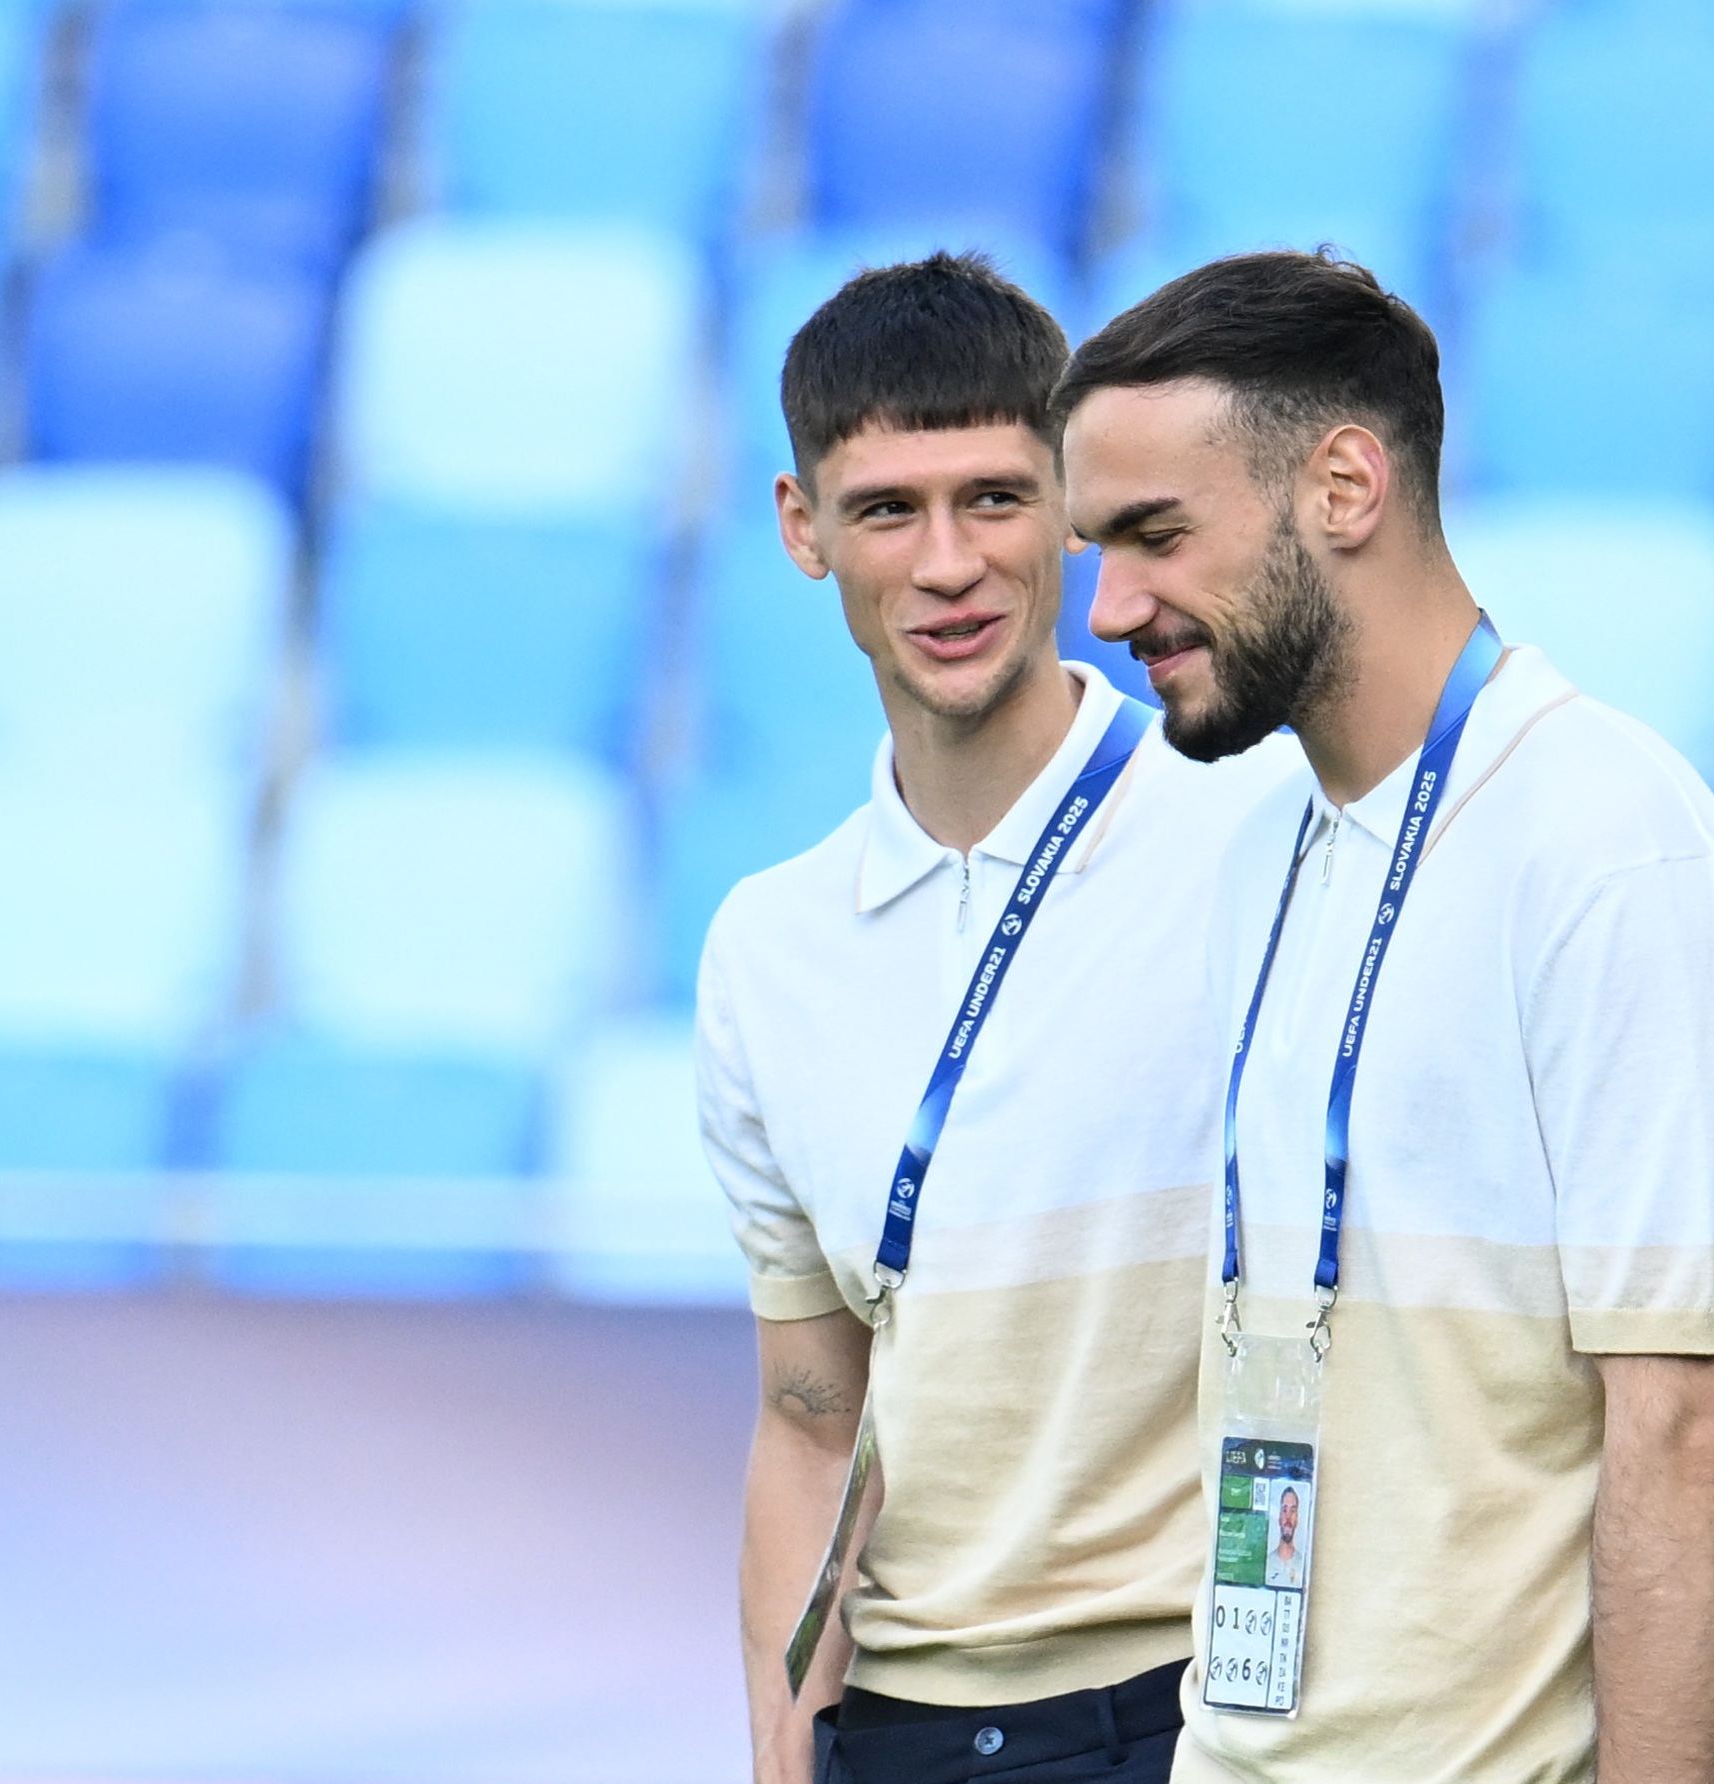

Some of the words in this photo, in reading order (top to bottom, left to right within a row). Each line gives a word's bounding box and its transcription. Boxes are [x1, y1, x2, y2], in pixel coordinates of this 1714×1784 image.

[948, 1018, 975, 1059] UEFA
[967, 946, 1006, 1018] UNDER21
[1017, 836, 1064, 904] SLOVAKIA
[1058, 796, 1089, 835] 2025
[1342, 1015, 1360, 1057] UEFA
[1353, 937, 1382, 1012] UNDER21
[1390, 816, 1423, 891] SLOVAKIA
[1414, 771, 1437, 812] 2025
[1242, 1658, 1251, 1681] 6
